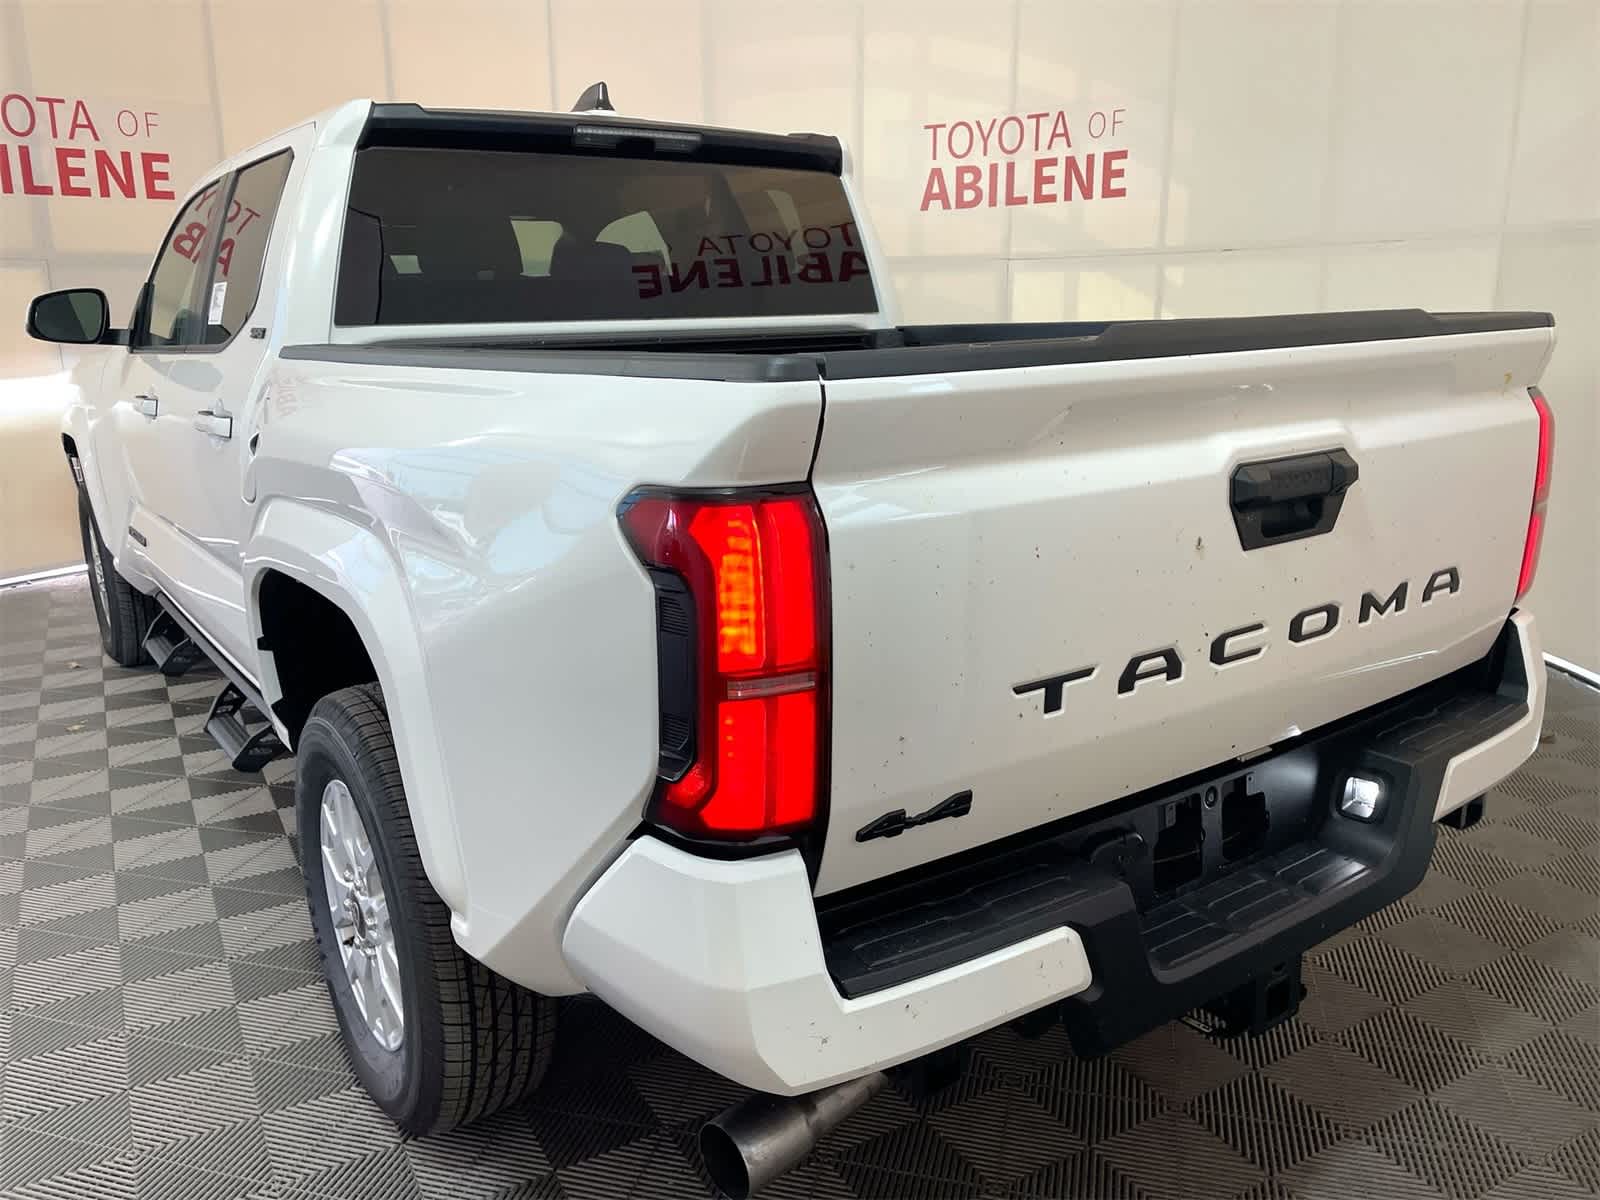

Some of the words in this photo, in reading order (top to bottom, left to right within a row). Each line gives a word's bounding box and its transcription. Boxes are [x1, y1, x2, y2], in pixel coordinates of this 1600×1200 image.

[117, 109, 160, 137] OF
[924, 110, 1072, 160] TOYOTA
[1088, 108, 1126, 139] OF
[920, 150, 1129, 211] ABILENE
[1012, 566, 1461, 716] TACOMA
